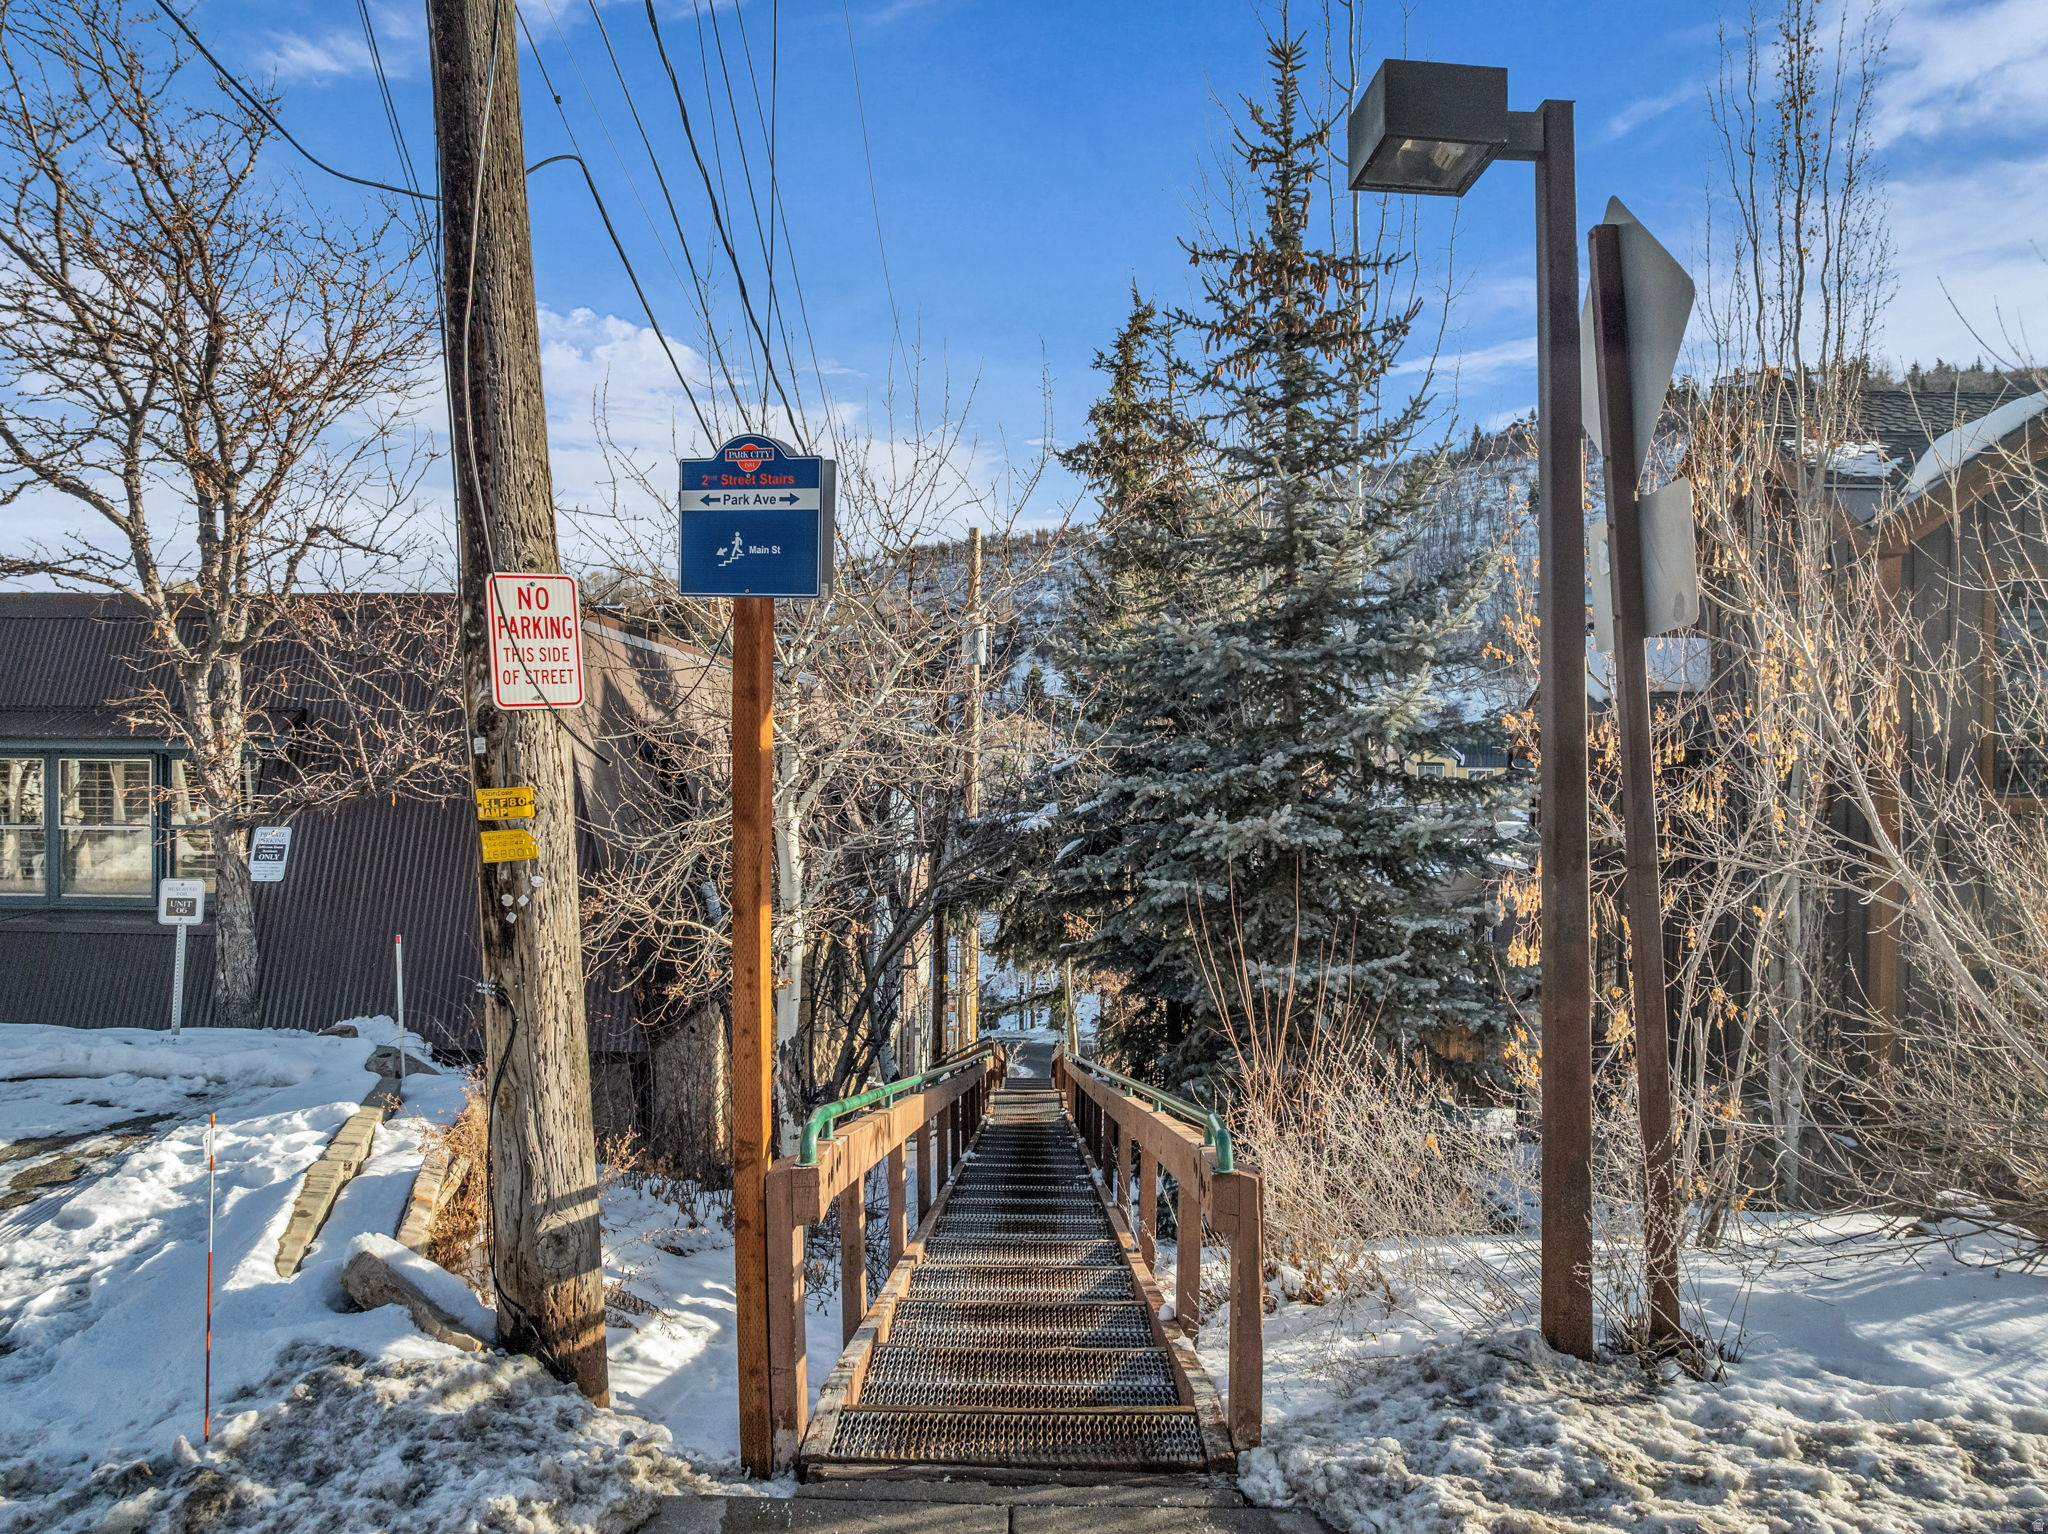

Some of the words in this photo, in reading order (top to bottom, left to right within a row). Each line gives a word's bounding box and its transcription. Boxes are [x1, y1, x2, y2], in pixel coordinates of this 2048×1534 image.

[728, 450, 749, 459] PARK
[750, 449, 771, 458] CITY
[721, 473, 756, 485] Street
[760, 473, 795, 485] Stairs
[723, 494, 750, 505] Park
[753, 494, 777, 505] Ave
[749, 546, 769, 554] Main
[771, 546, 781, 554] St
[517, 587, 550, 610] NO
[497, 615, 573, 640] PARKING
[503, 647, 535, 662] THIS
[539, 647, 570, 662] SIDE
[502, 670, 520, 685] OF
[525, 669, 574, 685] STREET
[484, 807, 508, 817] AMP
